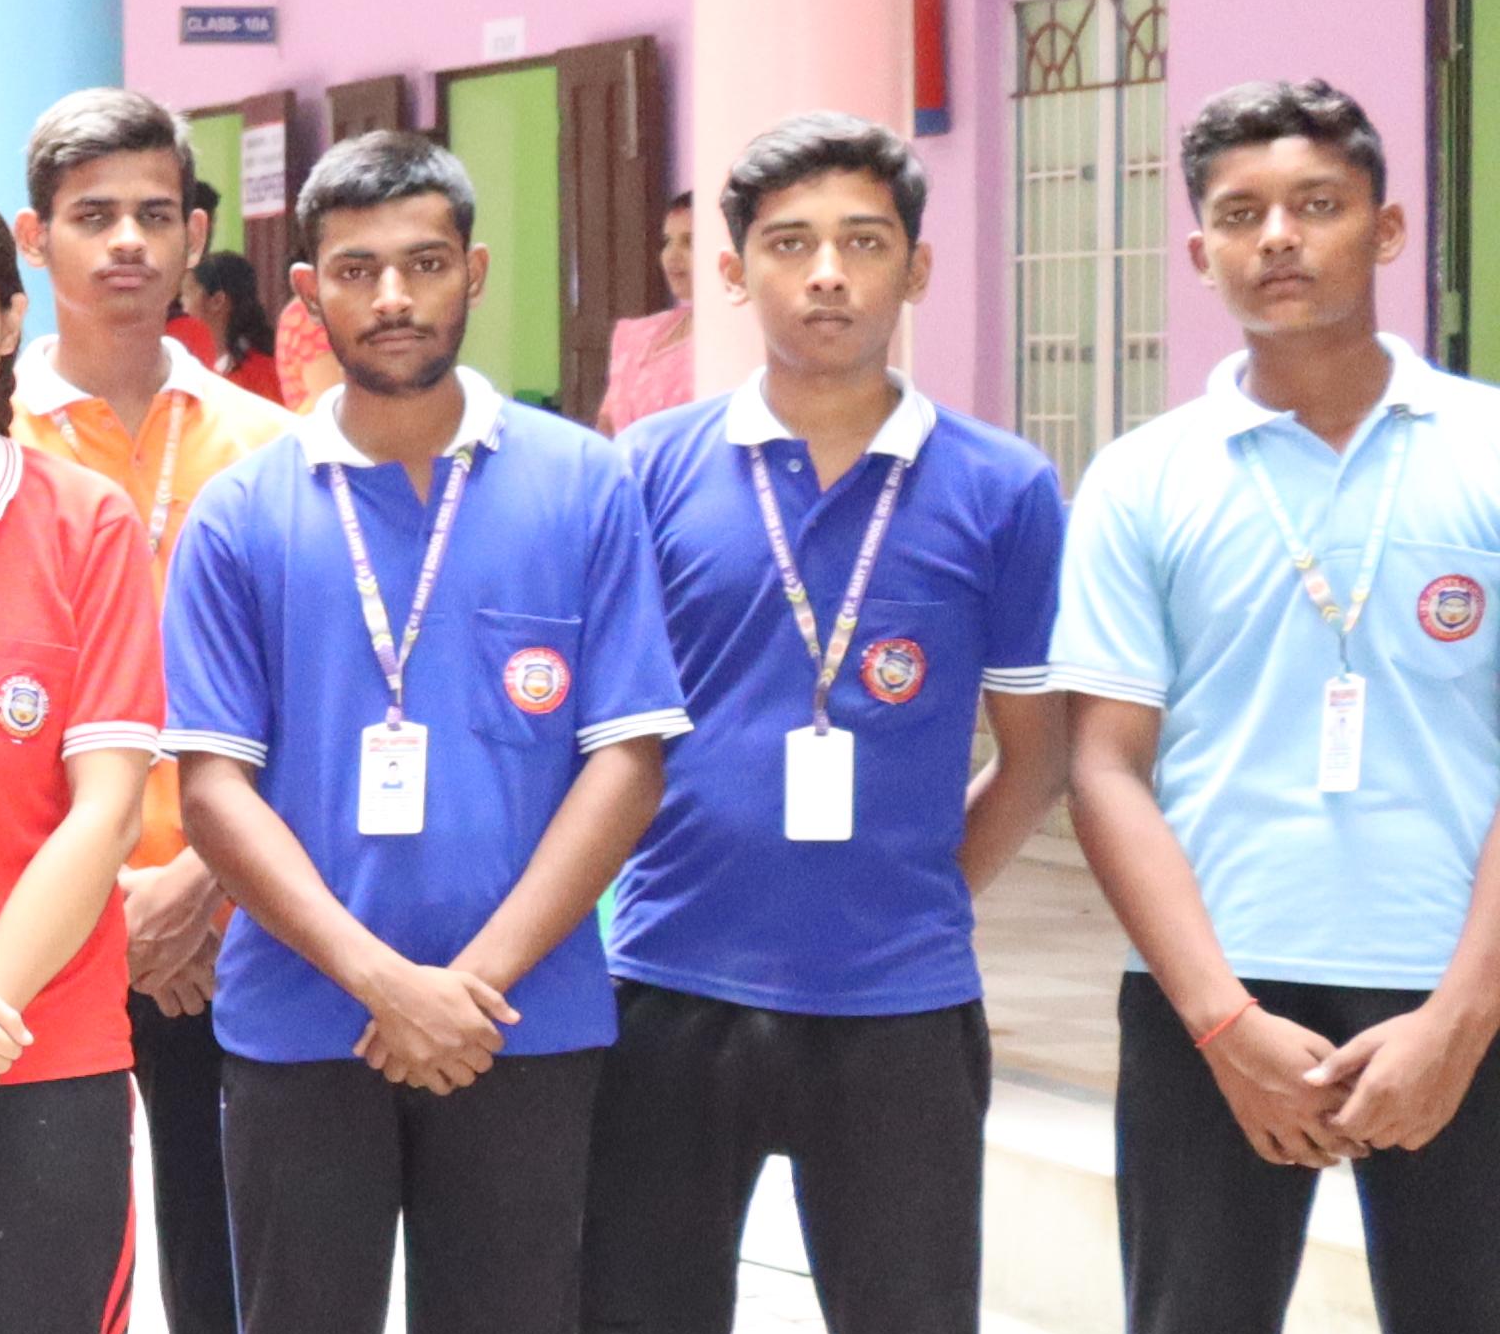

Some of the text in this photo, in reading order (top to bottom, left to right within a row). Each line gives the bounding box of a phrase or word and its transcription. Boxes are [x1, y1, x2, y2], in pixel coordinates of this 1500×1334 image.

[344, 521, 366, 561] MARY'S
[412, 570, 433, 611] MARY'S
[423, 531, 444, 571] SCHOOL
[847, 557, 871, 598] MARY'S
[861, 516, 884, 557] SCHOOL
